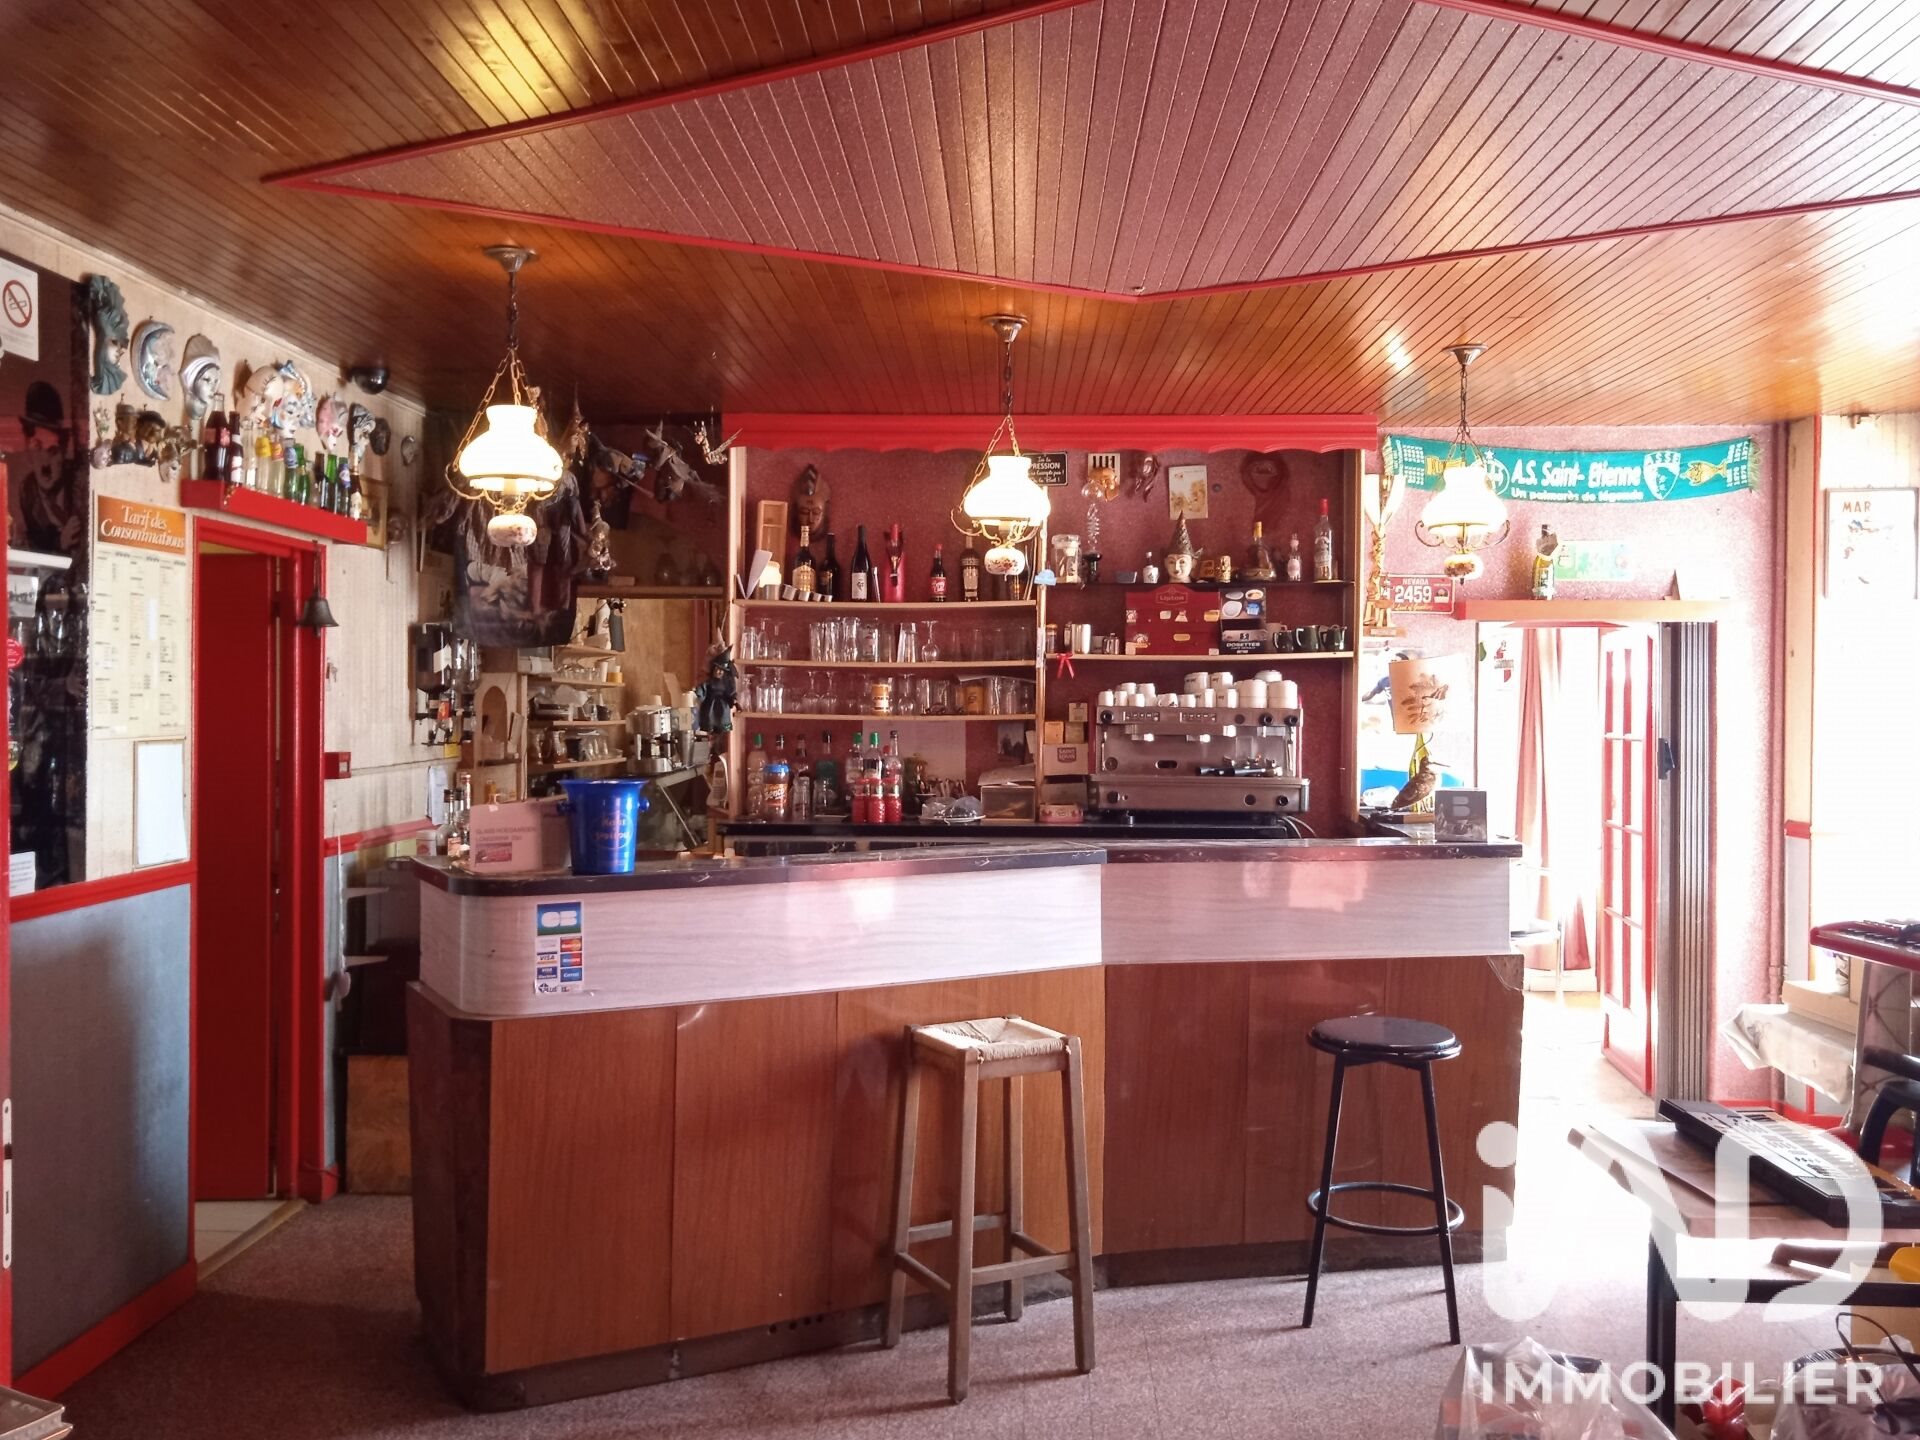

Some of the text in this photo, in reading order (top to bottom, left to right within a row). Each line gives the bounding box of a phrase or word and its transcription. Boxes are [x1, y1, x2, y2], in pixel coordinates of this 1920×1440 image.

[1582, 491, 1597, 501] de
[121, 504, 168, 531] Tarif des
[100, 518, 185, 548] Consommations
[1394, 585, 1432, 603] 2459
